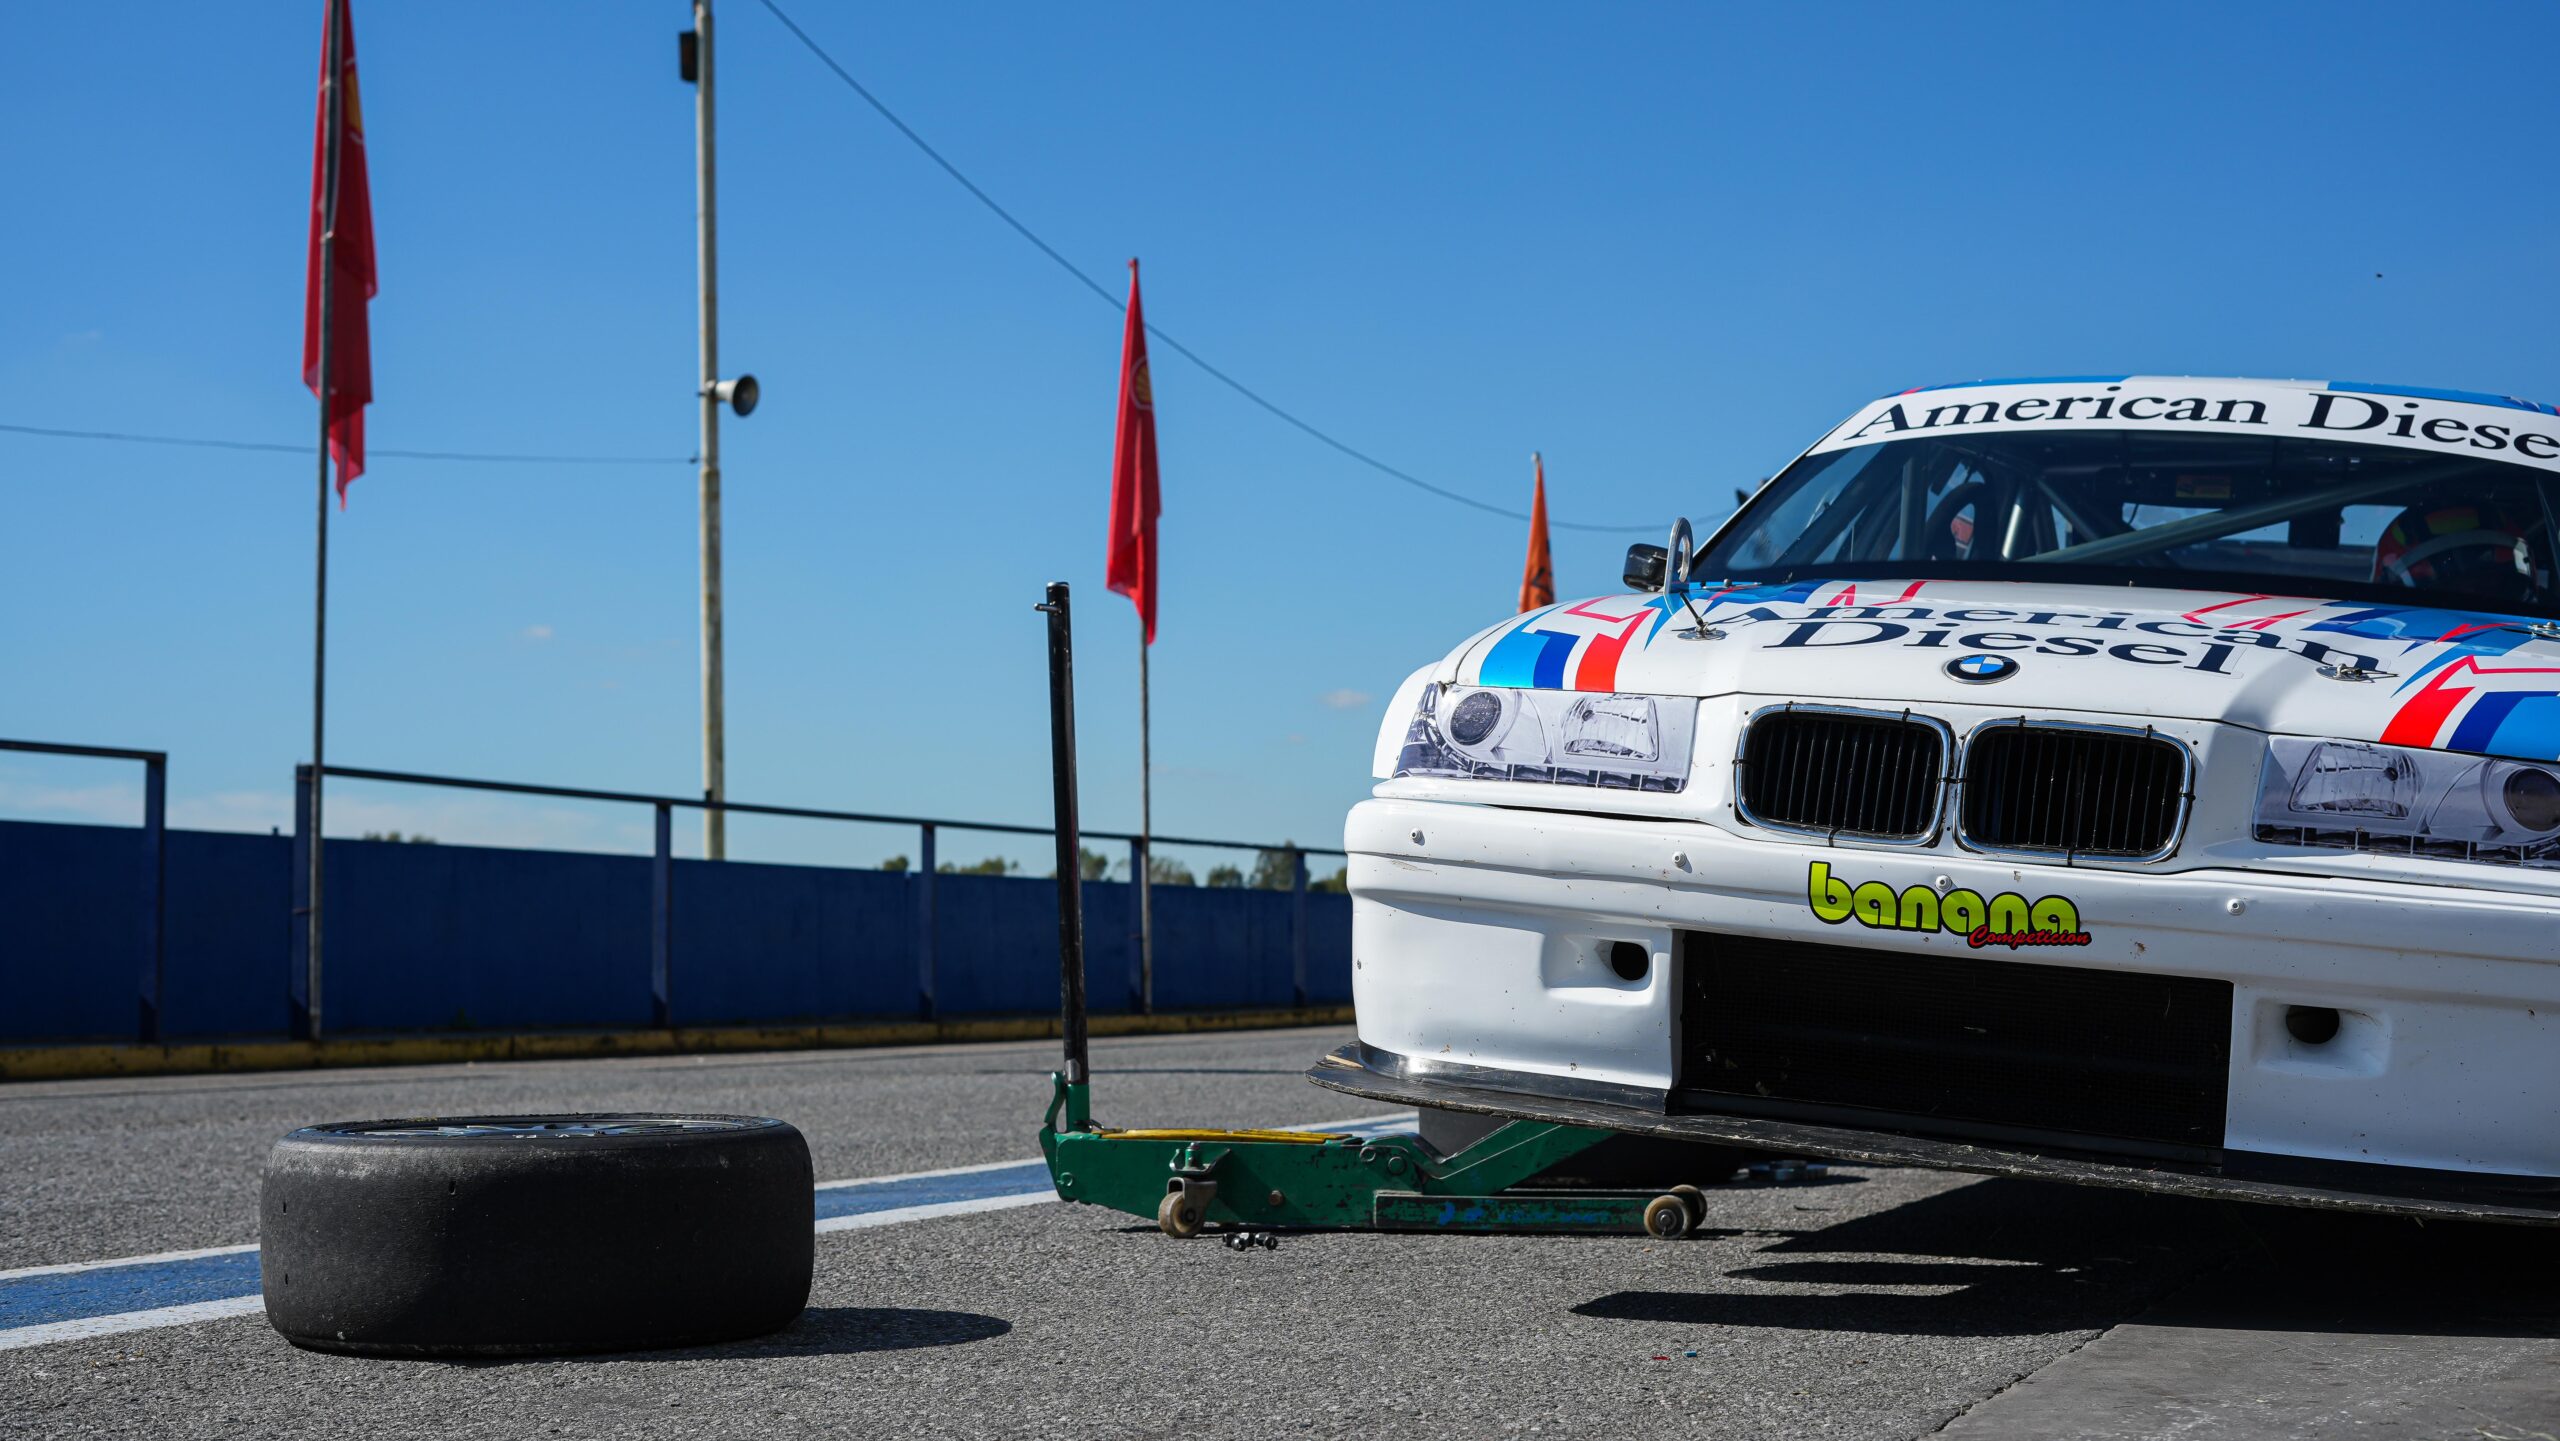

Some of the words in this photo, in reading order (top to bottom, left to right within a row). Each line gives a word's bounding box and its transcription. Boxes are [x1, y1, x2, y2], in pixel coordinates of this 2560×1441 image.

[1843, 386, 2269, 440] American
[1671, 606, 2388, 674] American
[1762, 621, 2231, 675] Diesel
[1808, 861, 2081, 937] banana
[1967, 923, 2092, 950] Competicion
